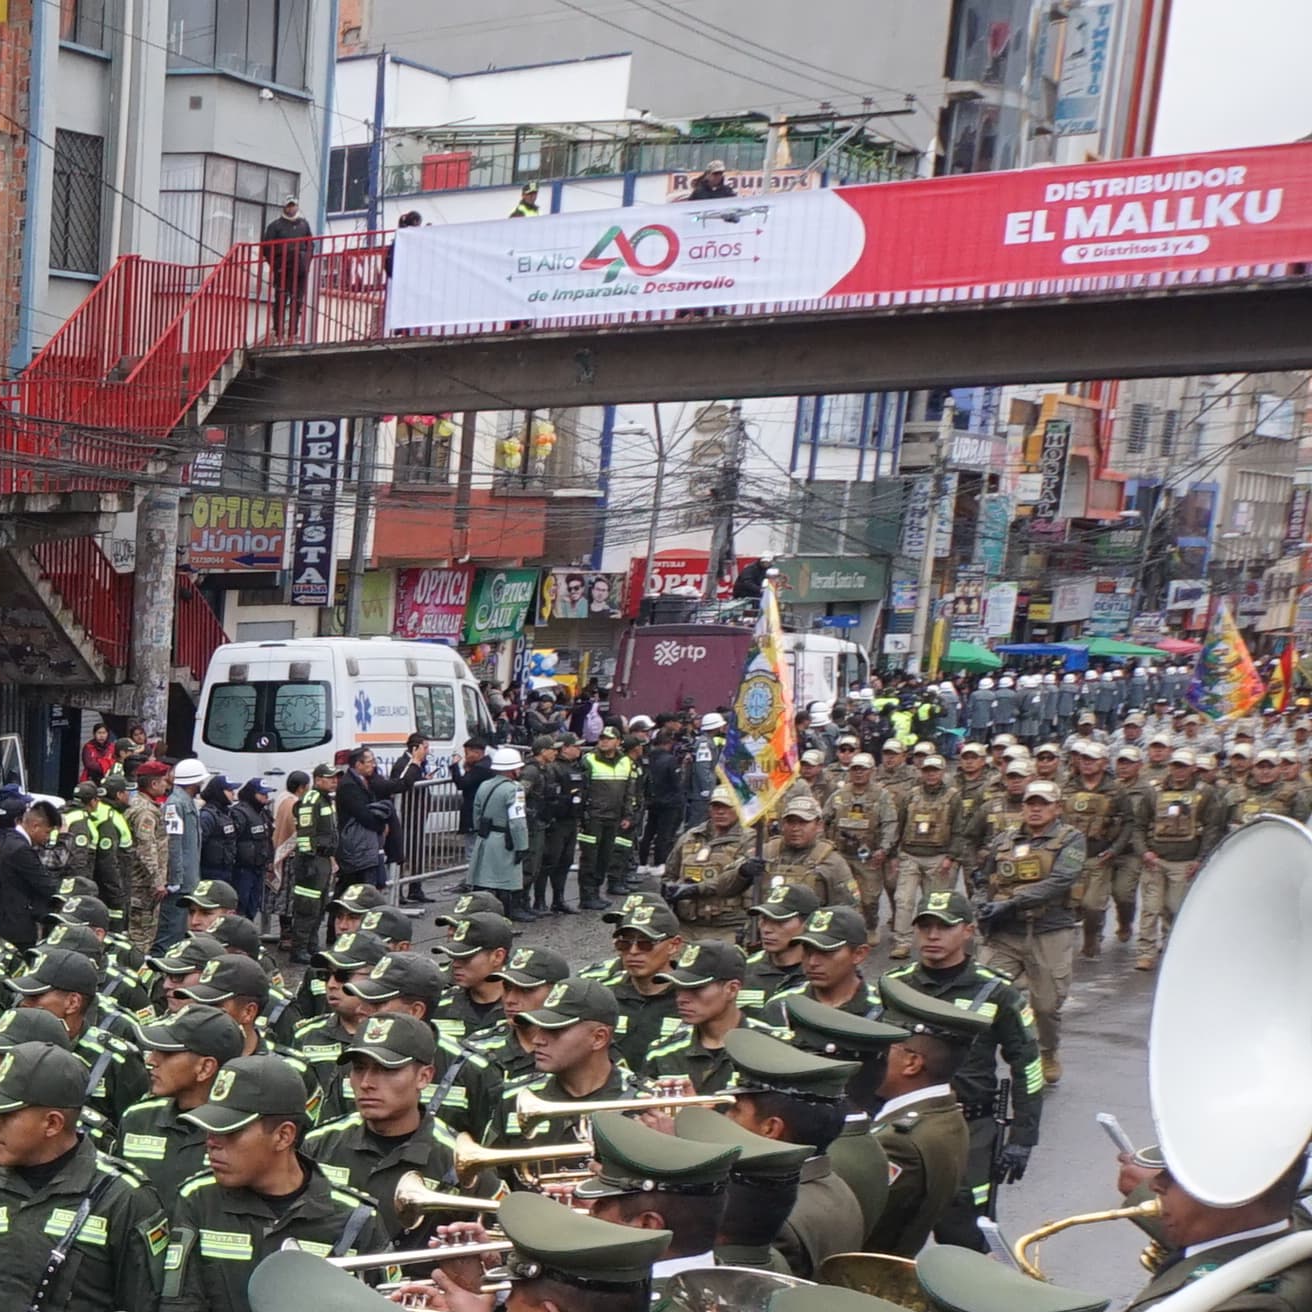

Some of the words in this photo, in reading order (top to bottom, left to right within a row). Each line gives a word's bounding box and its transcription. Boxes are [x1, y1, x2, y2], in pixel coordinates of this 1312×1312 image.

[1045, 165, 1248, 202] DISTRIBUIDOR
[1004, 210, 1056, 245] EL
[1064, 188, 1283, 240] MALLKU
[517, 255, 531, 273] El
[539, 254, 576, 273] Alto
[579, 224, 680, 284] 40
[688, 240, 743, 261] años
[1093, 241, 1157, 258] Distritos
[1172, 242, 1182, 256] y
[1185, 239, 1196, 252] 4
[528, 287, 549, 303] de
[552, 281, 638, 302] Imparable
[644, 276, 736, 295] Desarrollo
[1037, 432, 1066, 517] HOSTAL
[192, 496, 284, 529] OPTICA
[294, 420, 337, 584] DENTISTA
[413, 570, 468, 607] OPTICA
[490, 572, 533, 611] OPTICA
